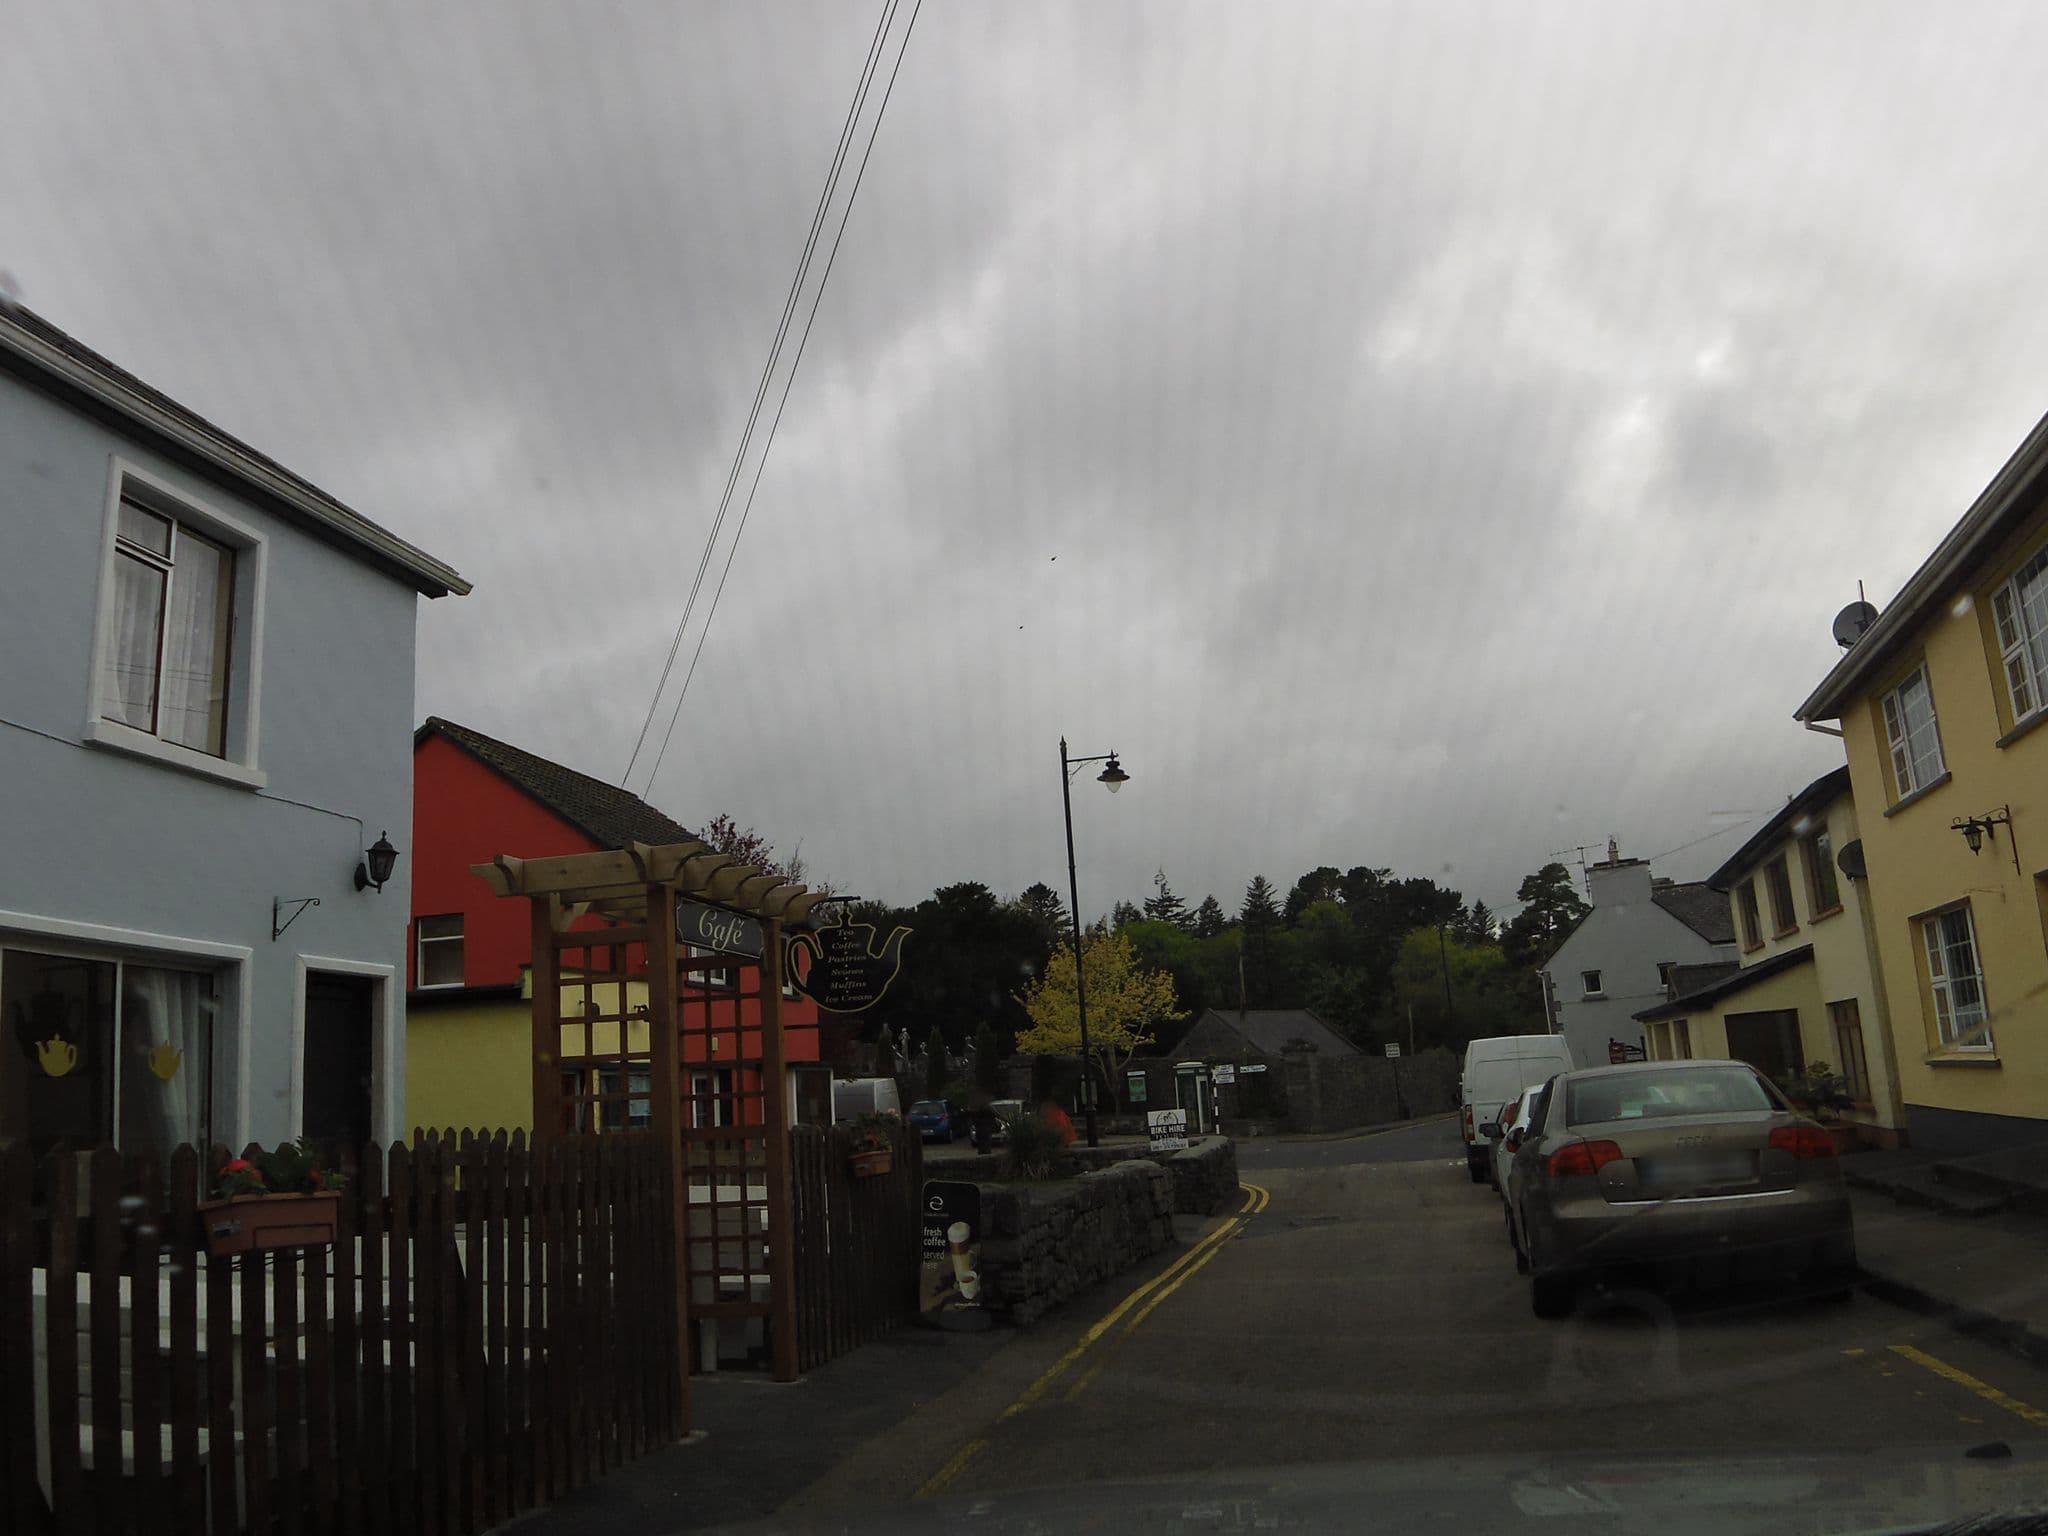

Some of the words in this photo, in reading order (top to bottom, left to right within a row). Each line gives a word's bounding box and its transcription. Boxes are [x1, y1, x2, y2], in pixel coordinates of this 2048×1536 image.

[698, 909, 745, 951] Café
[836, 929, 855, 937] Tea
[1150, 1126, 1168, 1135] BIKE
[1168, 1124, 1186, 1133] HIRE
[923, 1226, 942, 1237] fresh
[923, 1236, 946, 1246] coffee
